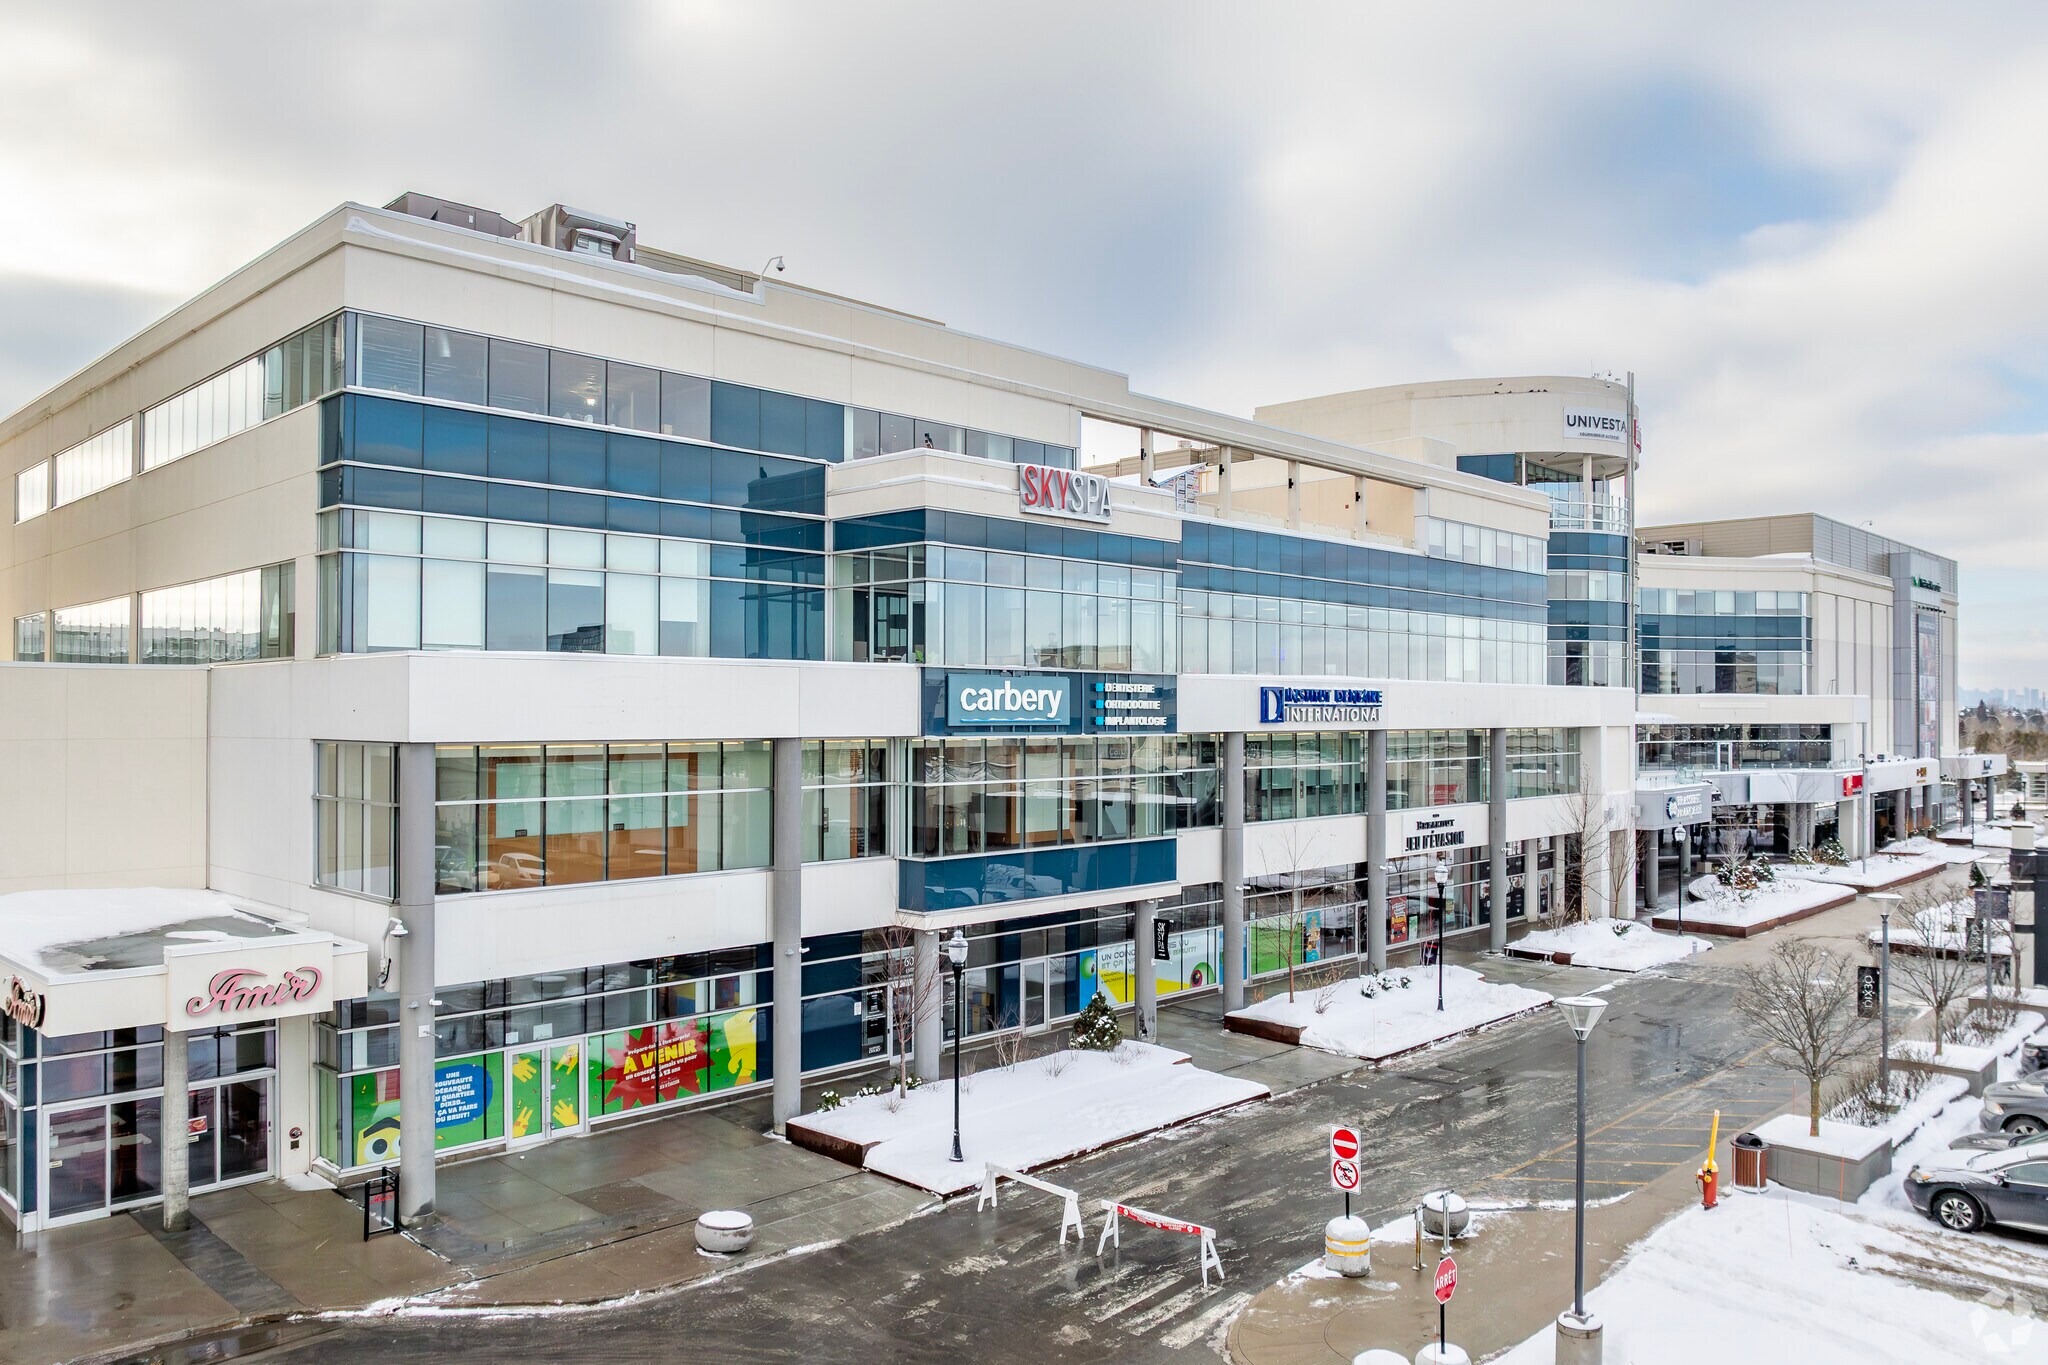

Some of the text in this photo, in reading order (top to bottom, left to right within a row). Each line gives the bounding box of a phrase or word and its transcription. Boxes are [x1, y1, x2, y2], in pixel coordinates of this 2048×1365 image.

[1566, 415, 1627, 433] UNIVESTA
[1023, 465, 1112, 517] SKYSPA
[1104, 682, 1155, 694] DENTISTERIE
[960, 680, 1063, 719] carbery
[1104, 699, 1161, 711] ORTHODONTIE
[1104, 716, 1167, 727] IMPLANTOLOGIE
[186, 966, 322, 1017] Amir
[641, 1039, 697, 1068] VENIR
[446, 1071, 459, 1079] UNE
[441, 1090, 475, 1102] QUARTIER
[459, 1103, 478, 1111] FAIRE
[1436, 1269, 1455, 1292] ARRÊT
